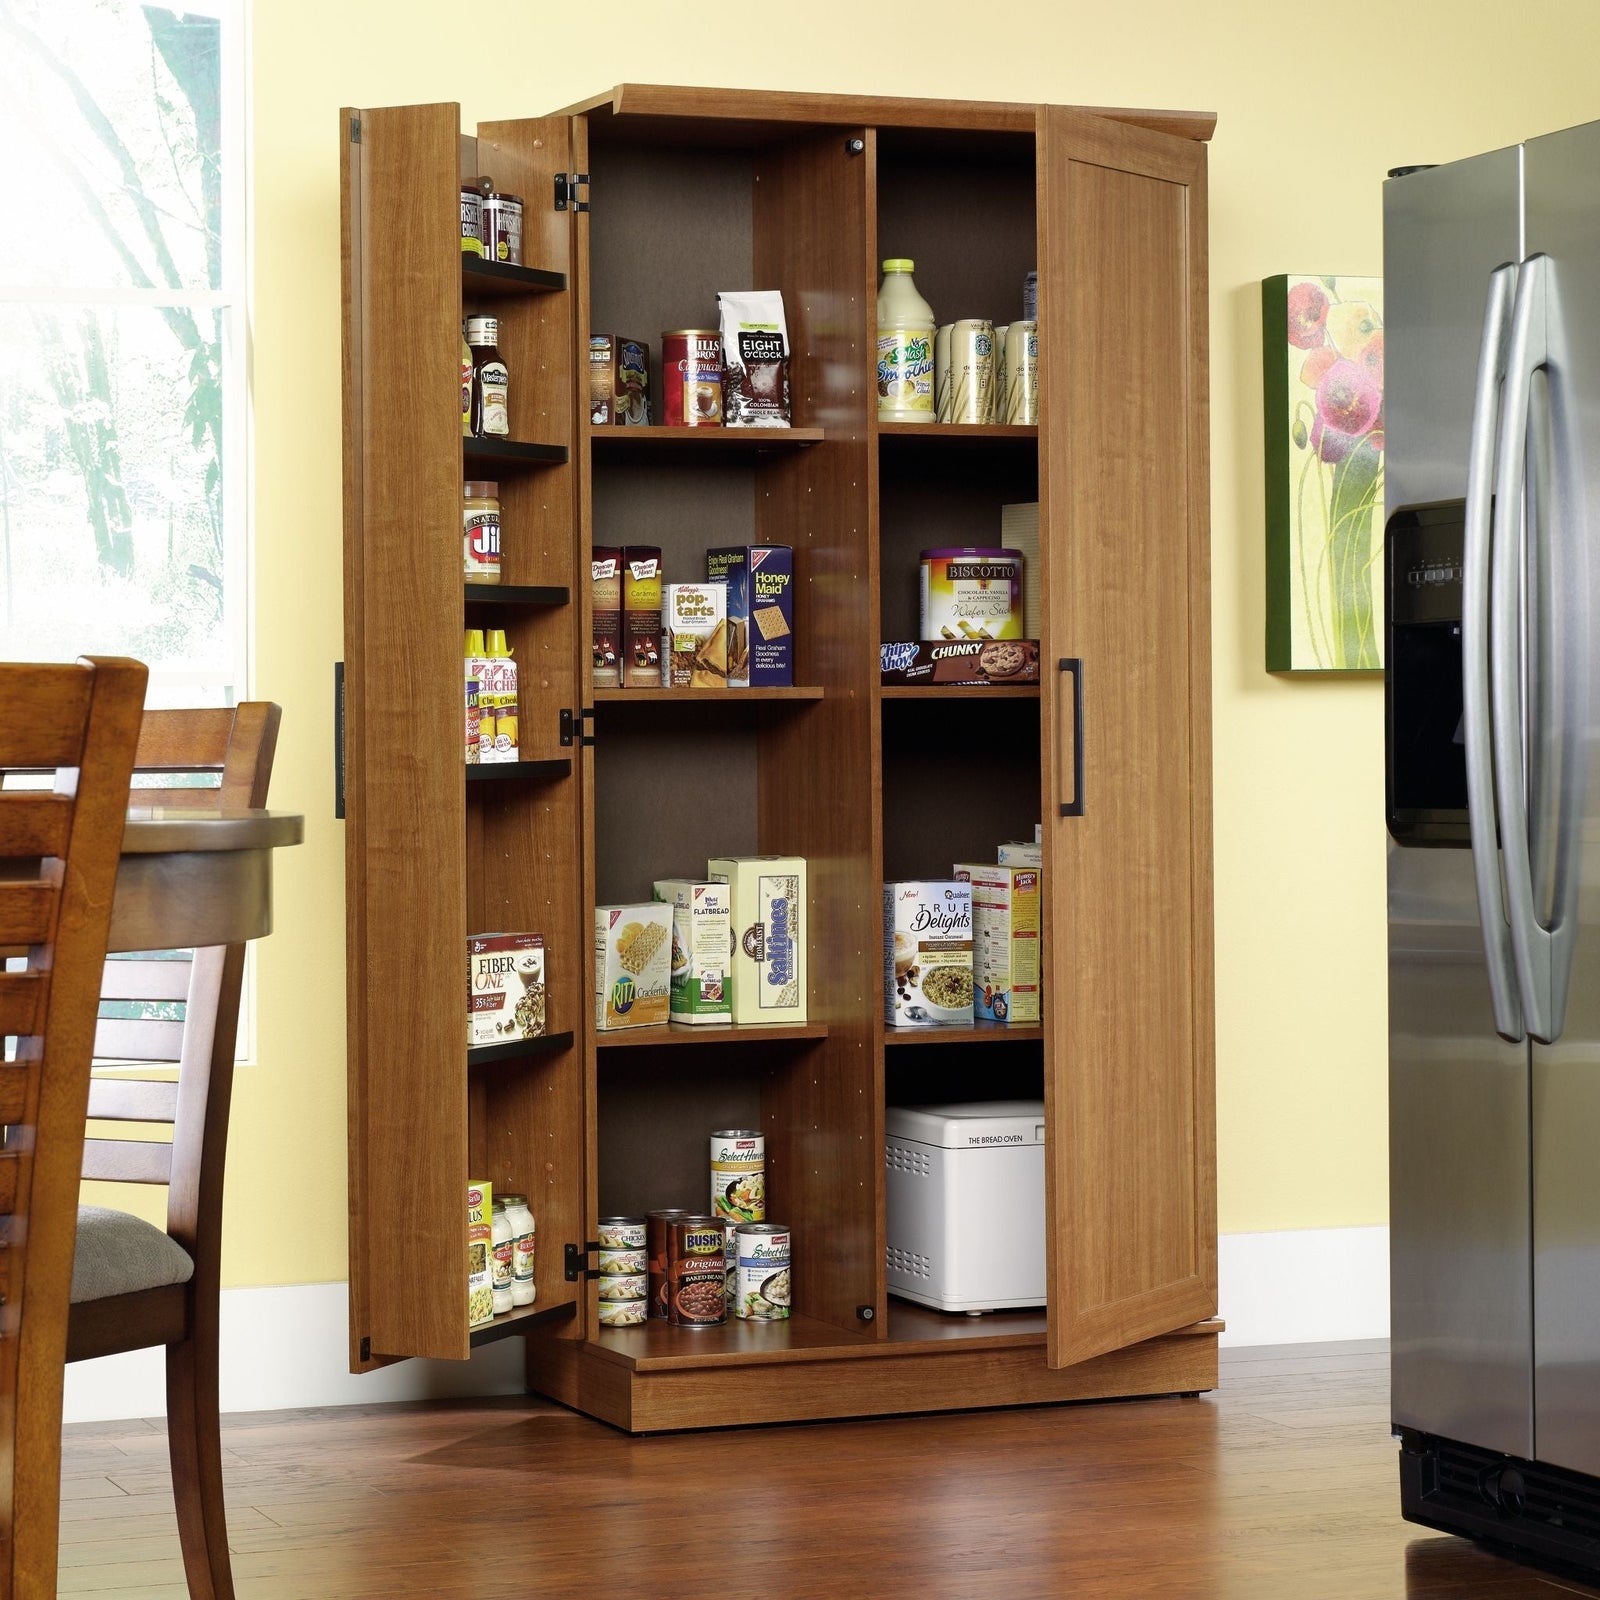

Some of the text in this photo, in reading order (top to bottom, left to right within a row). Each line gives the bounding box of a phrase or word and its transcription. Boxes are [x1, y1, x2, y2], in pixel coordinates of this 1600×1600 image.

[742, 340, 780, 350] EIGHT
[694, 350, 716, 360] BROS
[878, 360, 934, 382] Smothie
[708, 554, 744, 565] Enjoy Real Graham
[632, 563, 654, 572] Duncan
[949, 566, 1014, 578] BISCOTTO
[756, 572, 790, 586] Honey
[756, 584, 782, 594] Maid
[676, 594, 708, 606] pop-
[677, 606, 715, 616] tarts
[880, 642, 914, 658] Chips
[931, 643, 983, 660] CHUNKY
[899, 890, 918, 902] New!
[944, 890, 970, 900] Quaker
[918, 903, 970, 912] TRUE
[910, 910, 970, 934] Delights
[766, 898, 788, 986] Saltines
[480, 956, 516, 974] FIBER
[474, 973, 504, 990] ONE
[612, 981, 635, 1010] RITZ
[607, 1016, 612, 1026] 6
[981, 1136, 1003, 1144] BREAD
[1004, 1134, 1023, 1142] OVEN
[718, 1148, 744, 1163] Select
[686, 1233, 722, 1248] BUSH'S
[752, 1244, 779, 1260] Select
[685, 1259, 724, 1269] Original
